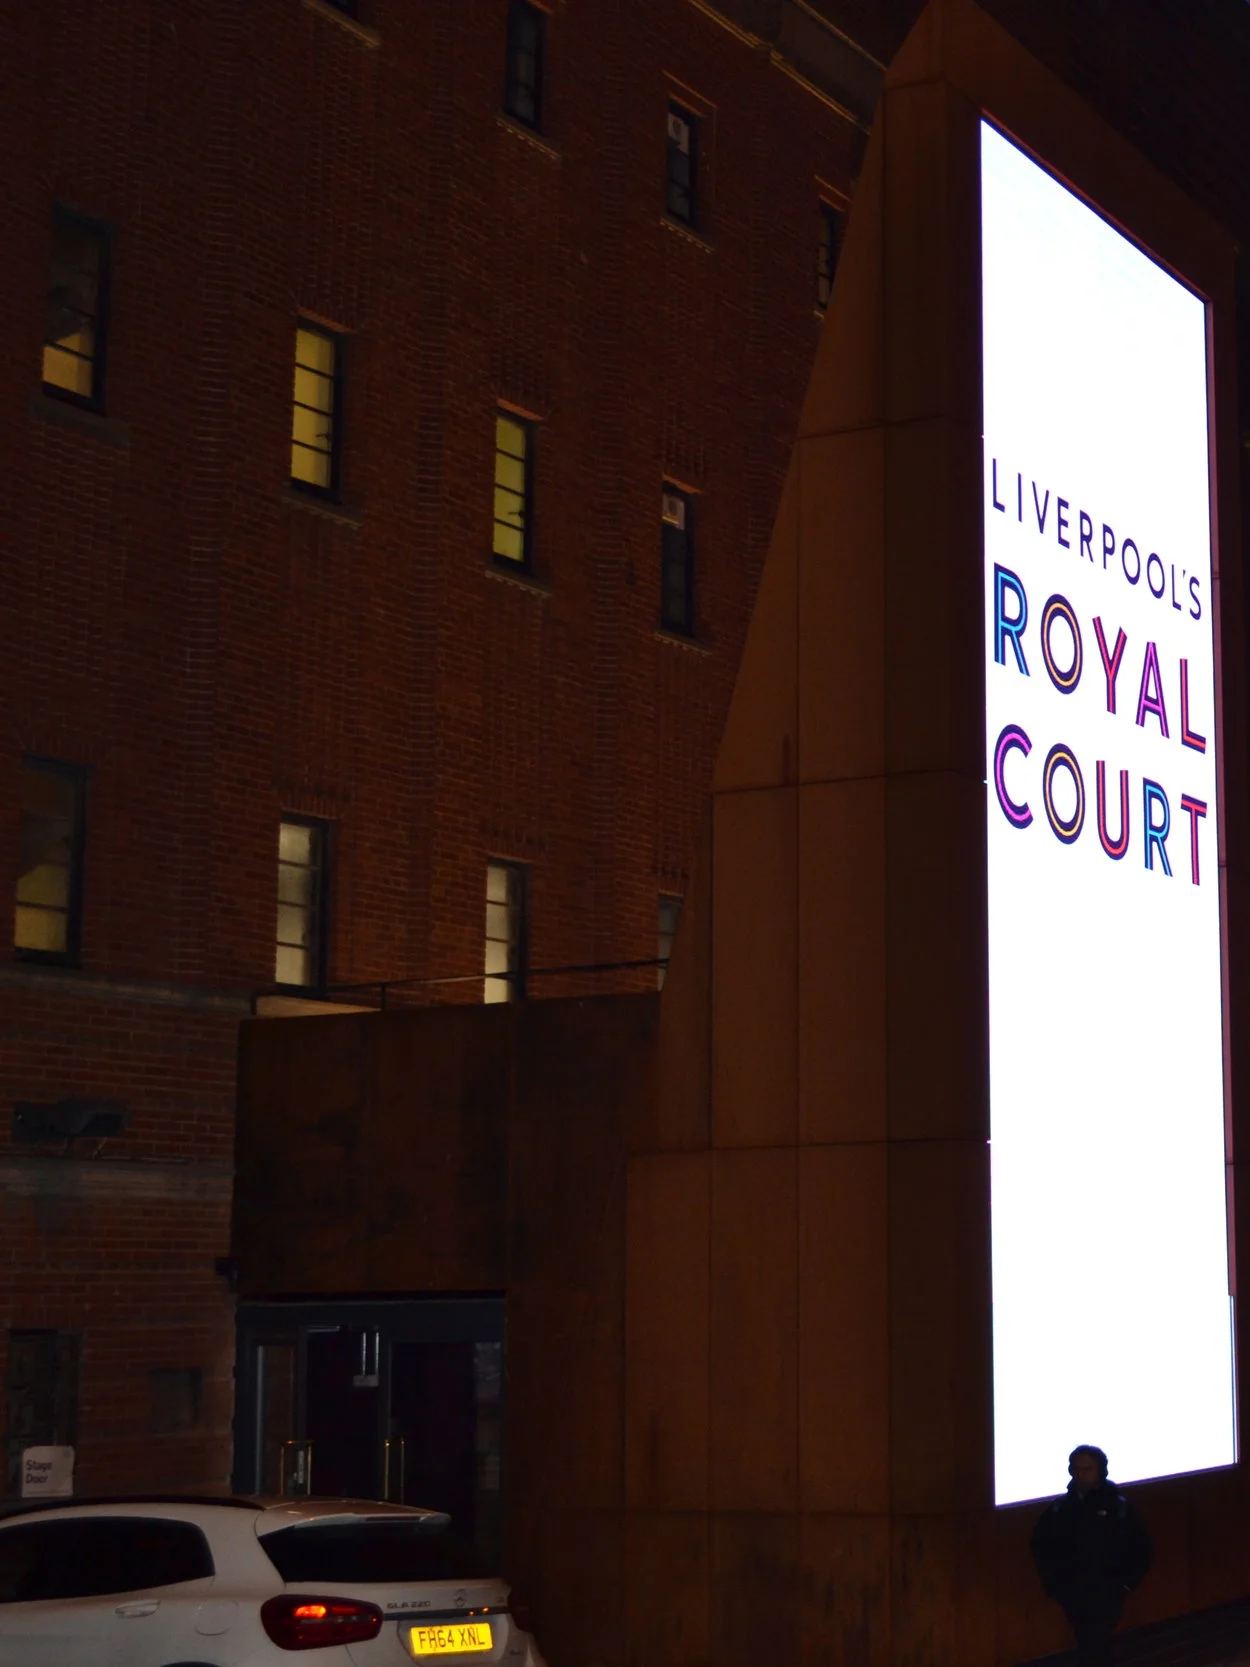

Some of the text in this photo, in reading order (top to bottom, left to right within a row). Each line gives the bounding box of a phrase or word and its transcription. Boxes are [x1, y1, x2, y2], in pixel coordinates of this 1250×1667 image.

[992, 457, 1202, 621] LIVERPOOL'S
[993, 561, 1207, 754] ROYAL
[993, 723, 1208, 887] COURT
[25, 1473, 49, 1485] Door
[457, 1626, 486, 1647] XNL
